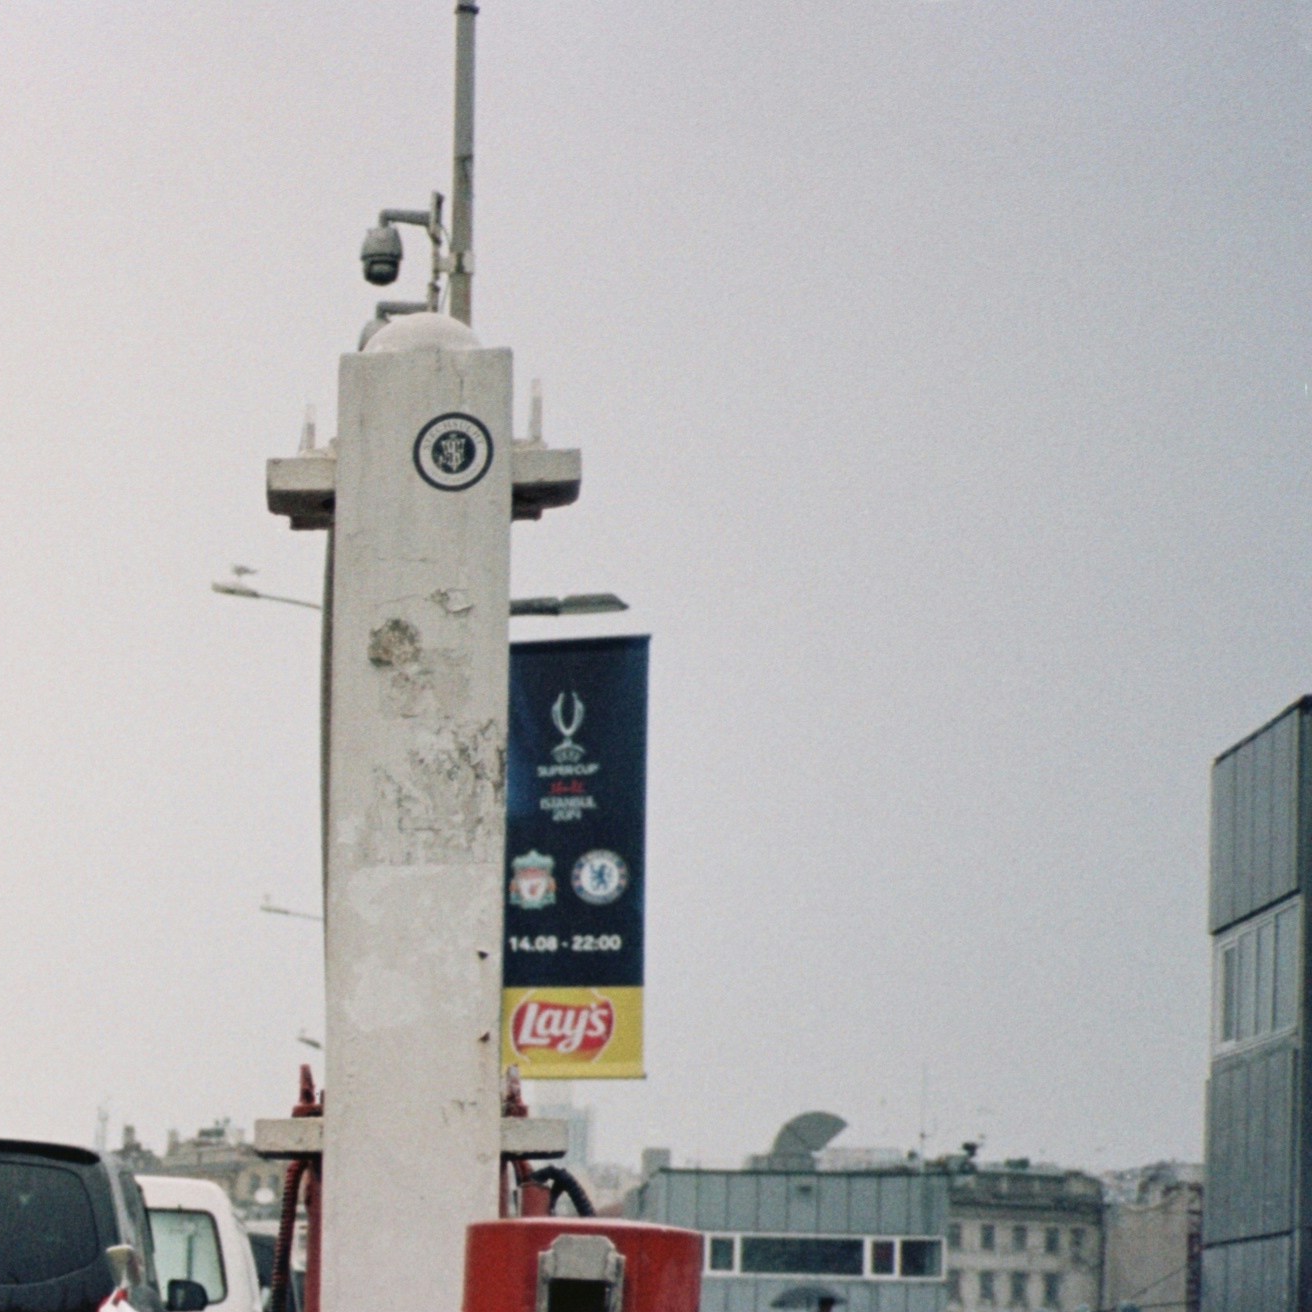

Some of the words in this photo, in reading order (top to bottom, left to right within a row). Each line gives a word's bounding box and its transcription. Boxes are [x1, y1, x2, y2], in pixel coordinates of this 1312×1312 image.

[509, 935, 558, 952] 14.08
[571, 933, 622, 951] 22:00
[518, 1002, 609, 1054] Lay's
